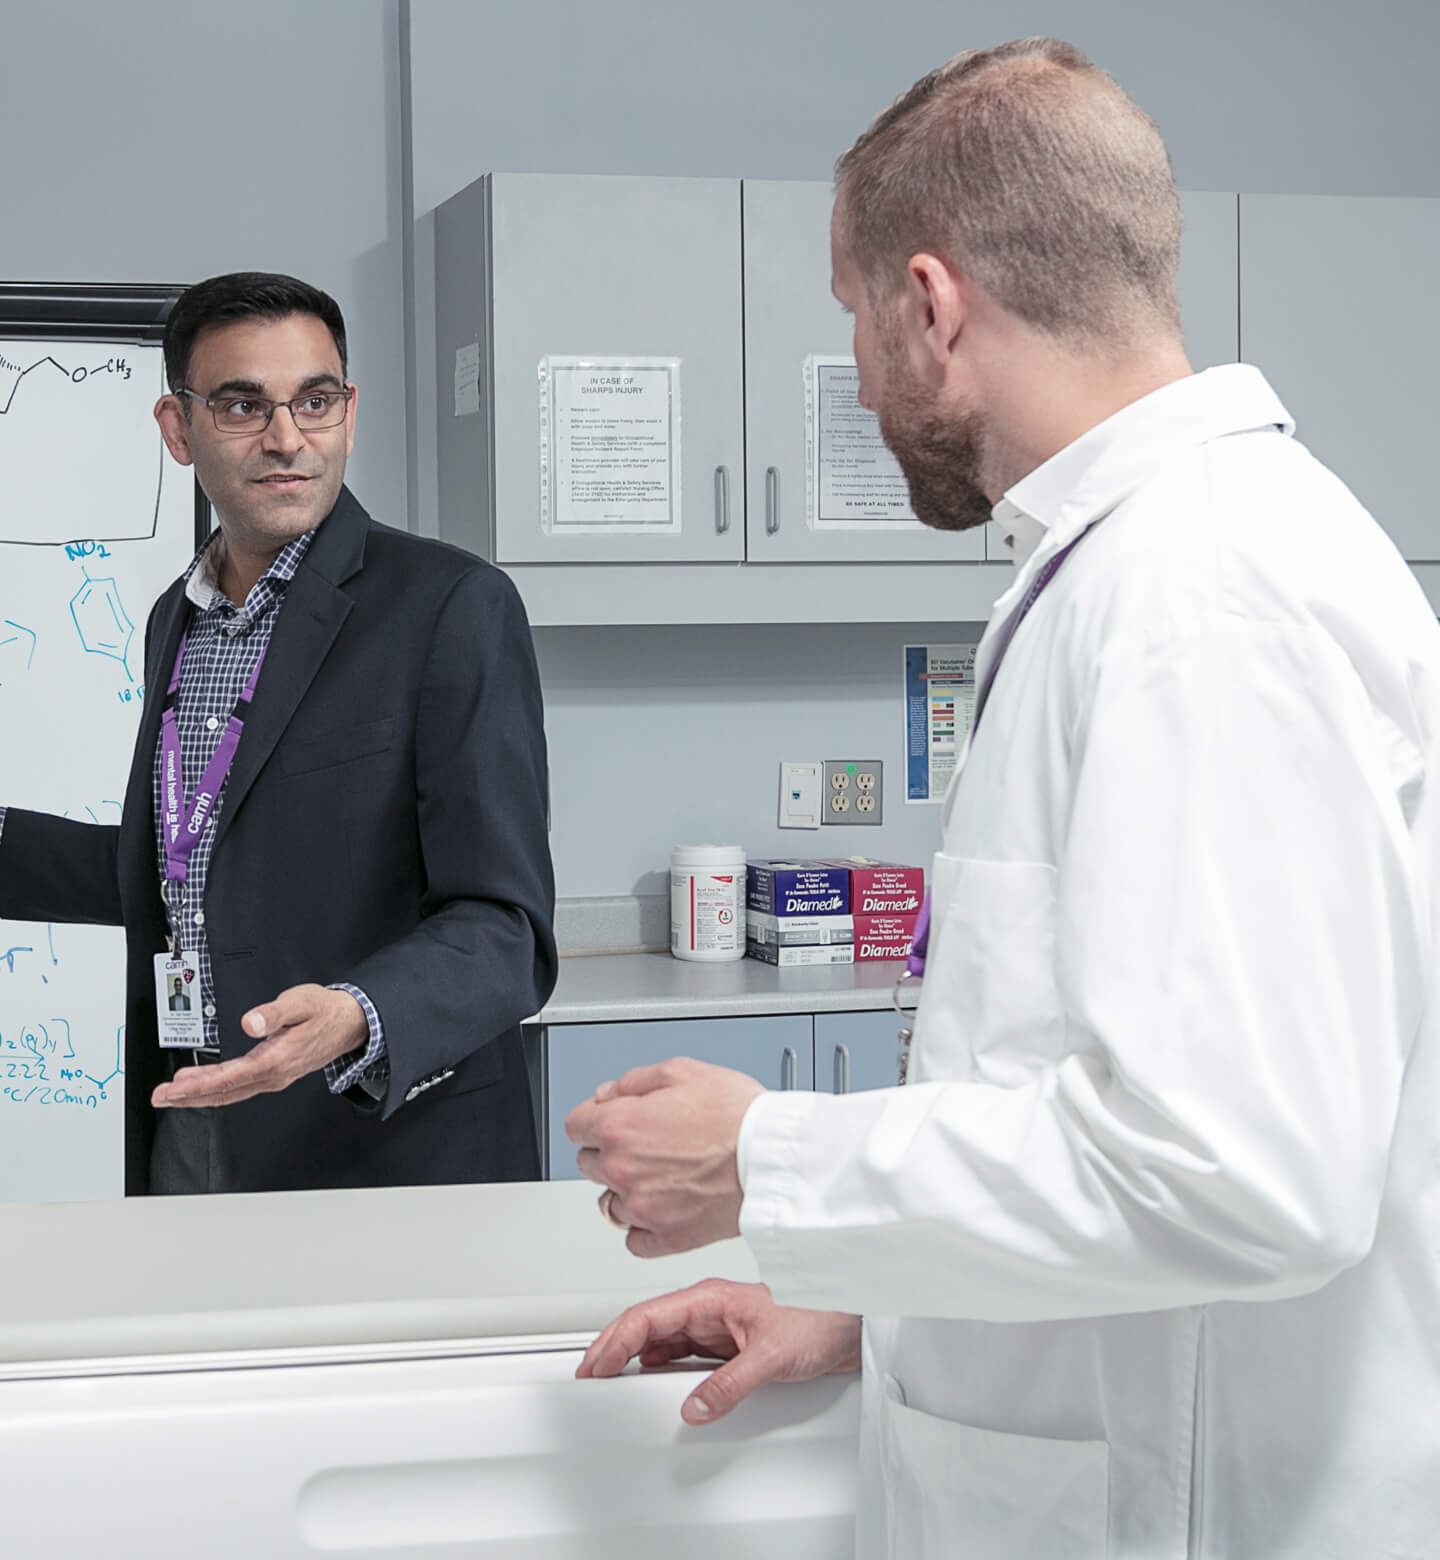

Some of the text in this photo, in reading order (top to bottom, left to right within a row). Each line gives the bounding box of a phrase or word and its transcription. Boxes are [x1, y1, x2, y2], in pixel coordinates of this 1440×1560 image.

[600, 377, 621, 385] CASE
[622, 377, 635, 385] OF
[580, 386, 644, 395] SHARPS INJURY
[167, 750, 177, 781] mental
[167, 781, 179, 812] health
[187, 792, 213, 834] camh
[786, 896, 833, 912] Diamed
[862, 896, 909, 912] Diamed
[859, 943, 906, 957] Diamed
